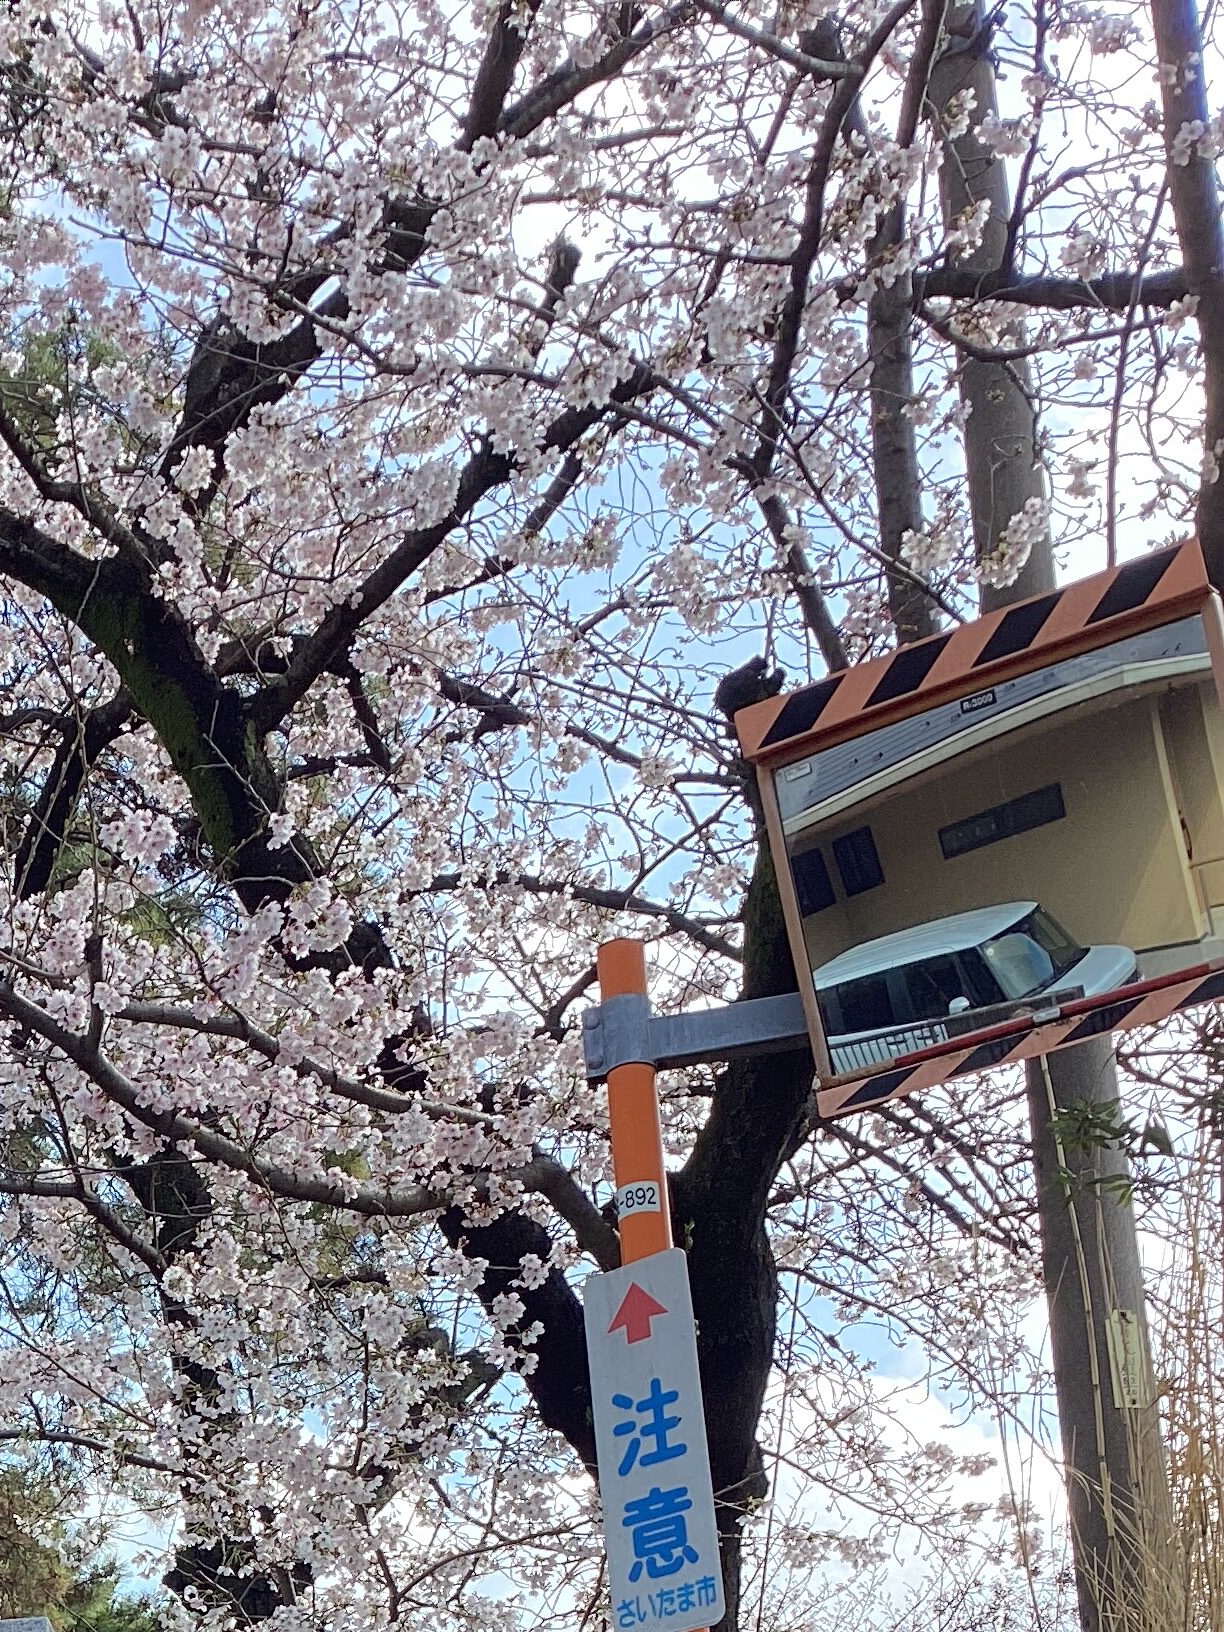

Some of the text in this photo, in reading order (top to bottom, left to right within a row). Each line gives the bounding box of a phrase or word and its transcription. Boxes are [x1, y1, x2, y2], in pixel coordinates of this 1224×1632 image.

[611, 1377, 700, 1583] 注意
[617, 1575, 717, 1628] さいたま市
